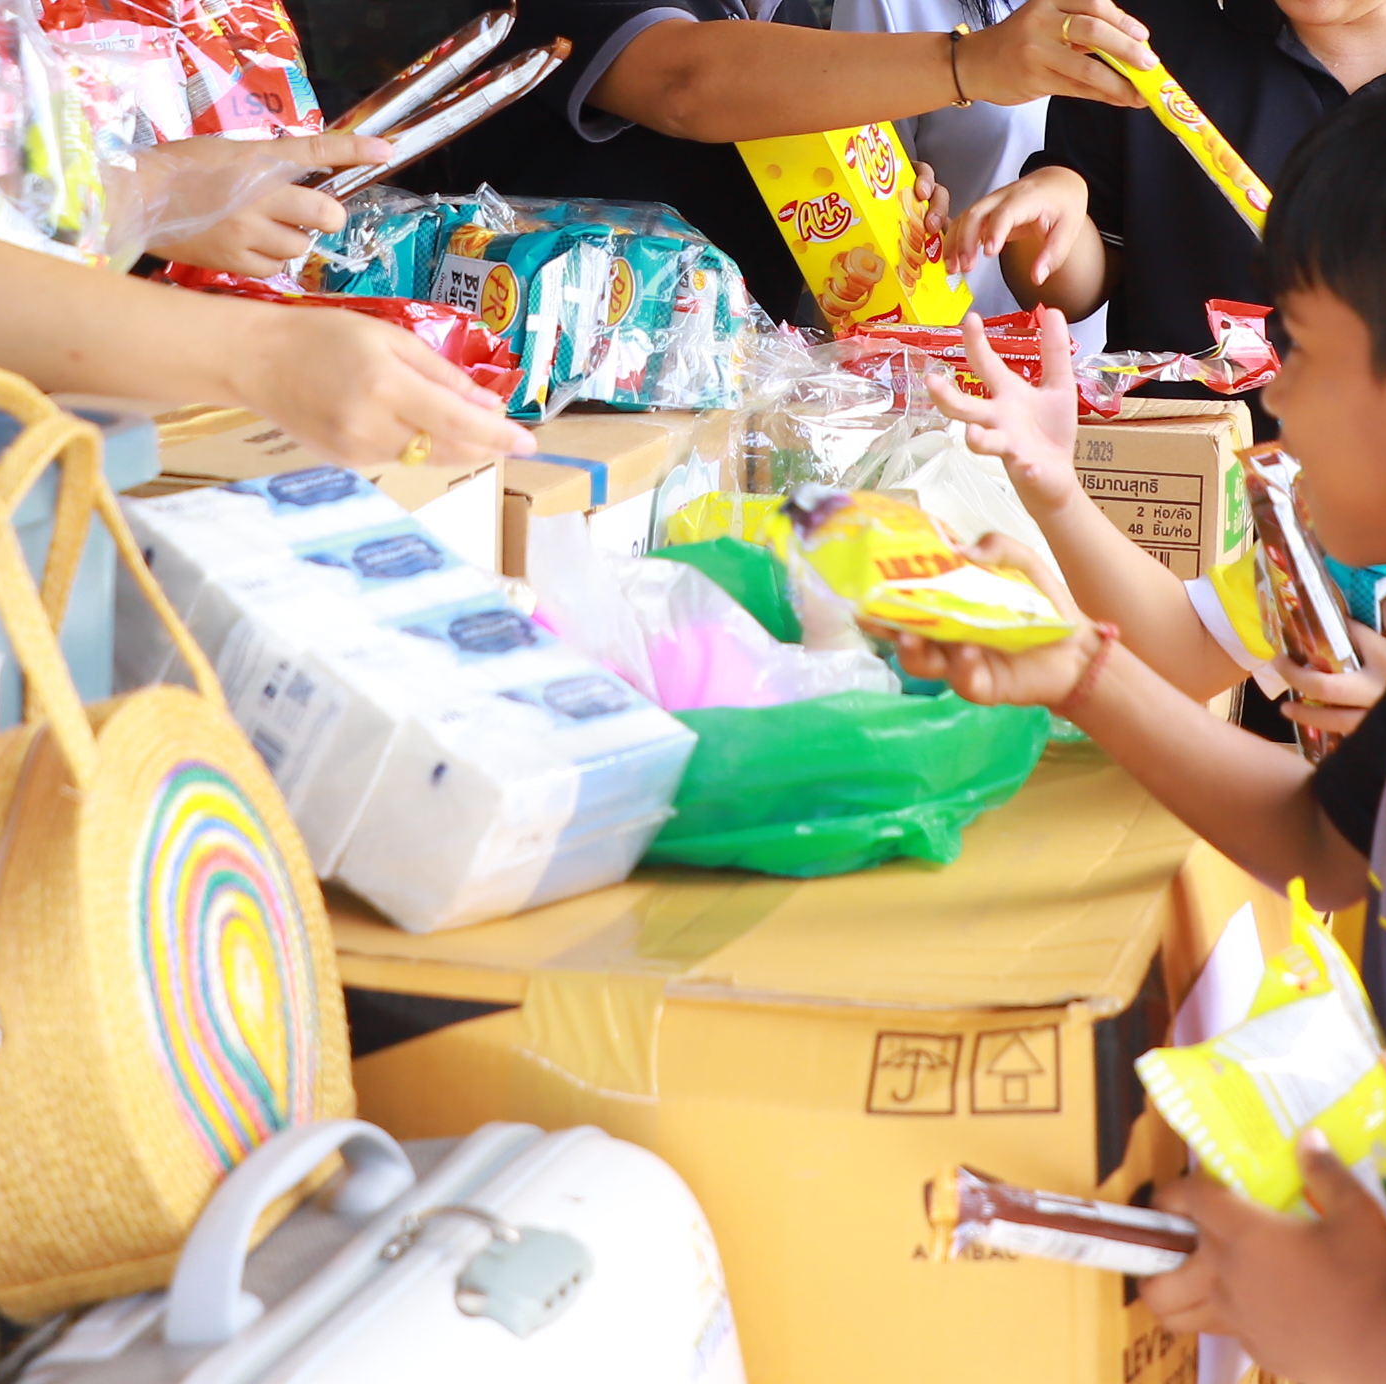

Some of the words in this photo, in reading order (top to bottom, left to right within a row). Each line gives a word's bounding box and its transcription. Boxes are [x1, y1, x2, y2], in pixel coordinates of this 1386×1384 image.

[1136, 506, 1145, 518] 2
[1153, 504, 1192, 521] ห่อ/ลัง
[1128, 523, 1144, 535] 48
